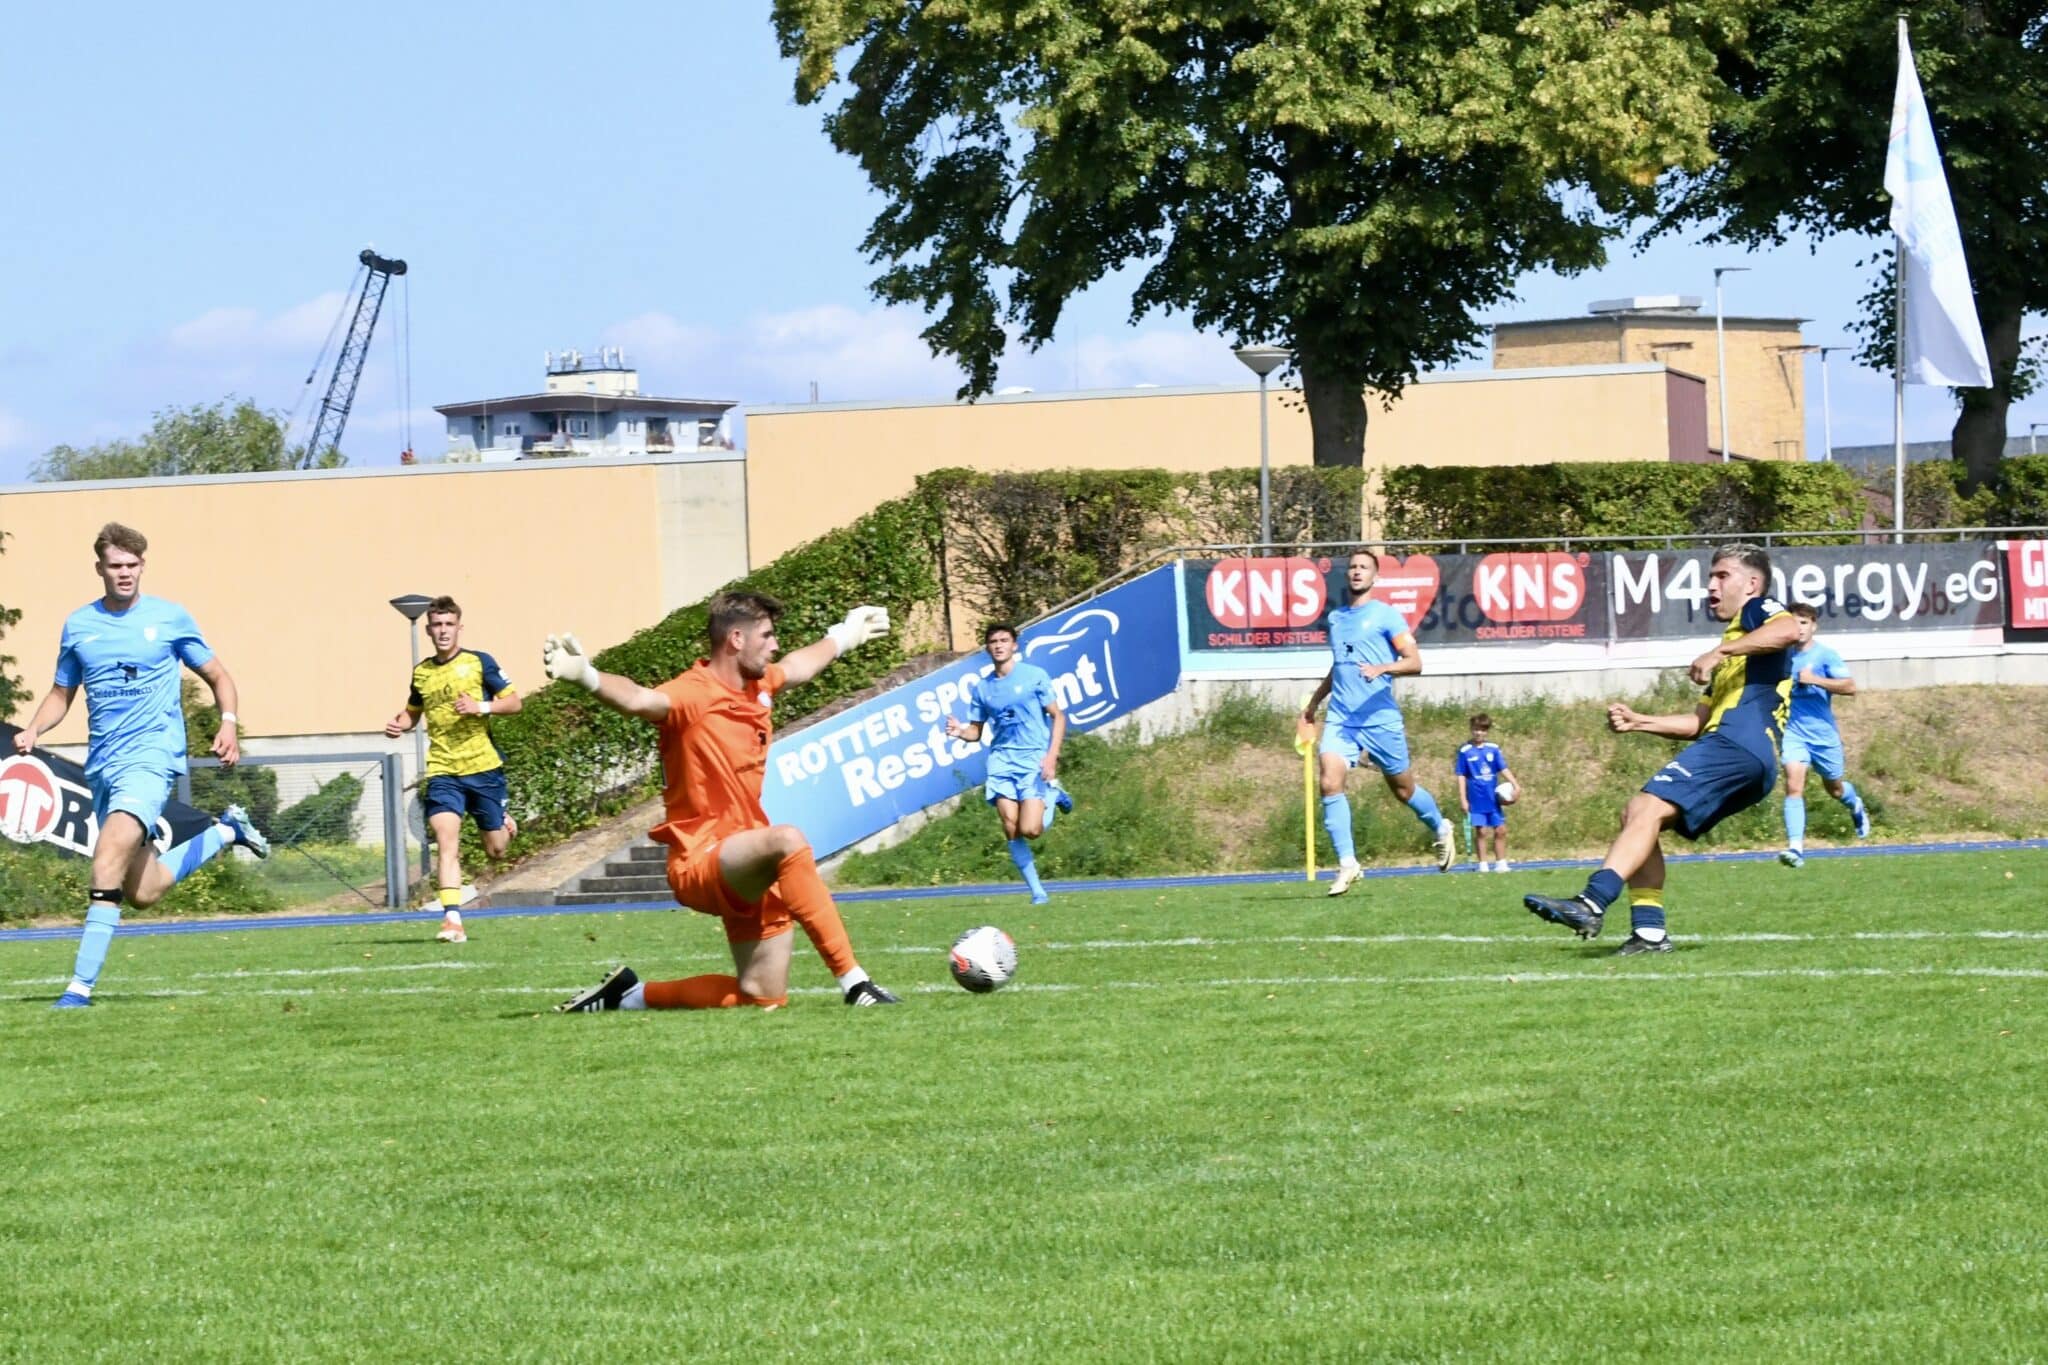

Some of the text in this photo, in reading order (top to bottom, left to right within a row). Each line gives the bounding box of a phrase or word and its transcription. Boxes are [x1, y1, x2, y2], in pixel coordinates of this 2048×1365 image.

[1478, 563, 1578, 610] KNS
[1613, 553, 1928, 621] M4nergy
[1945, 560, 1997, 602] eG
[2021, 541, 2048, 589] G
[1211, 569, 1319, 616] KNS
[1208, 631, 1328, 646] SCHILDER SYSTEME
[1476, 624, 1586, 639] SCHILDER SYSTEME
[775, 653, 1023, 787] ROTTER SPO
[840, 653, 1103, 807] Restant
